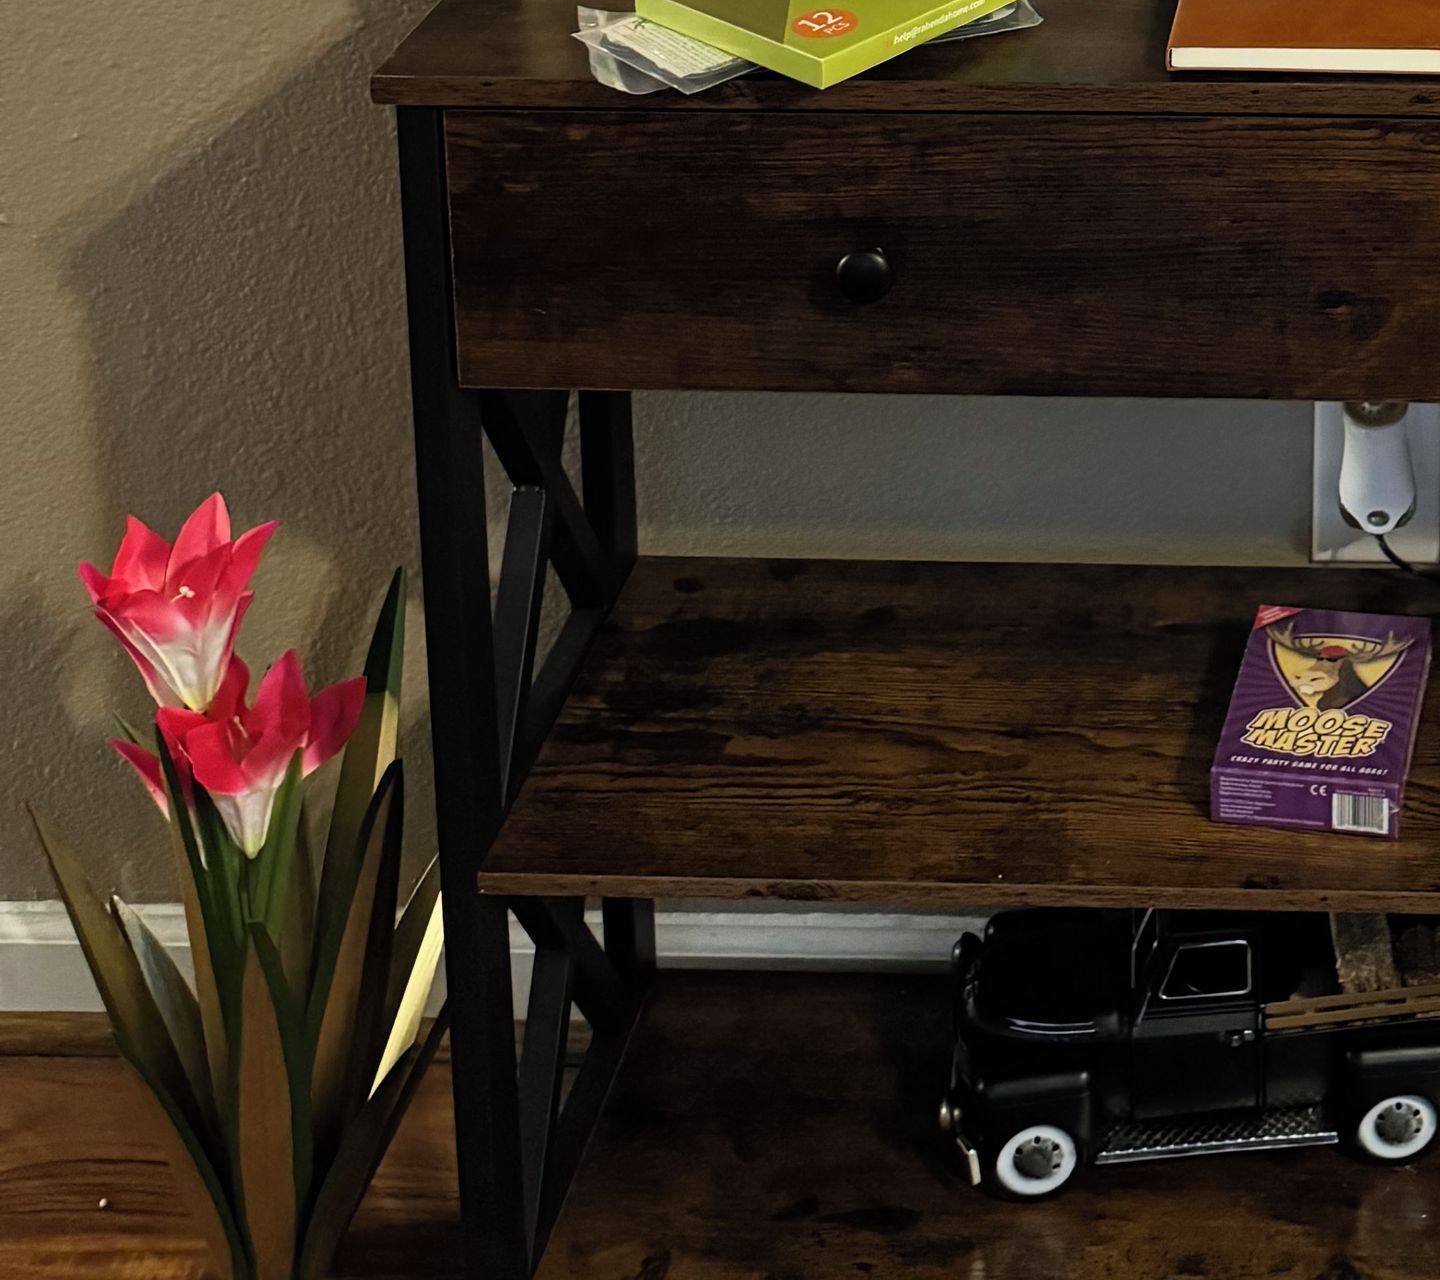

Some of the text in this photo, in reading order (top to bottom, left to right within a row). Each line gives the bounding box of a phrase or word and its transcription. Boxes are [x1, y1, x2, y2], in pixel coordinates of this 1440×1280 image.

[797, 11, 844, 32] 12
[824, 20, 851, 35] PCS
[1249, 707, 1390, 738] MOOSE
[1243, 728, 1378, 756] MASTER
[1230, 755, 1259, 763] CRAZY
[1262, 758, 1290, 767] PARTY
[1291, 760, 1318, 770] GAME
[1319, 763, 1337, 771] FOR
[1340, 765, 1357, 773] ALL
